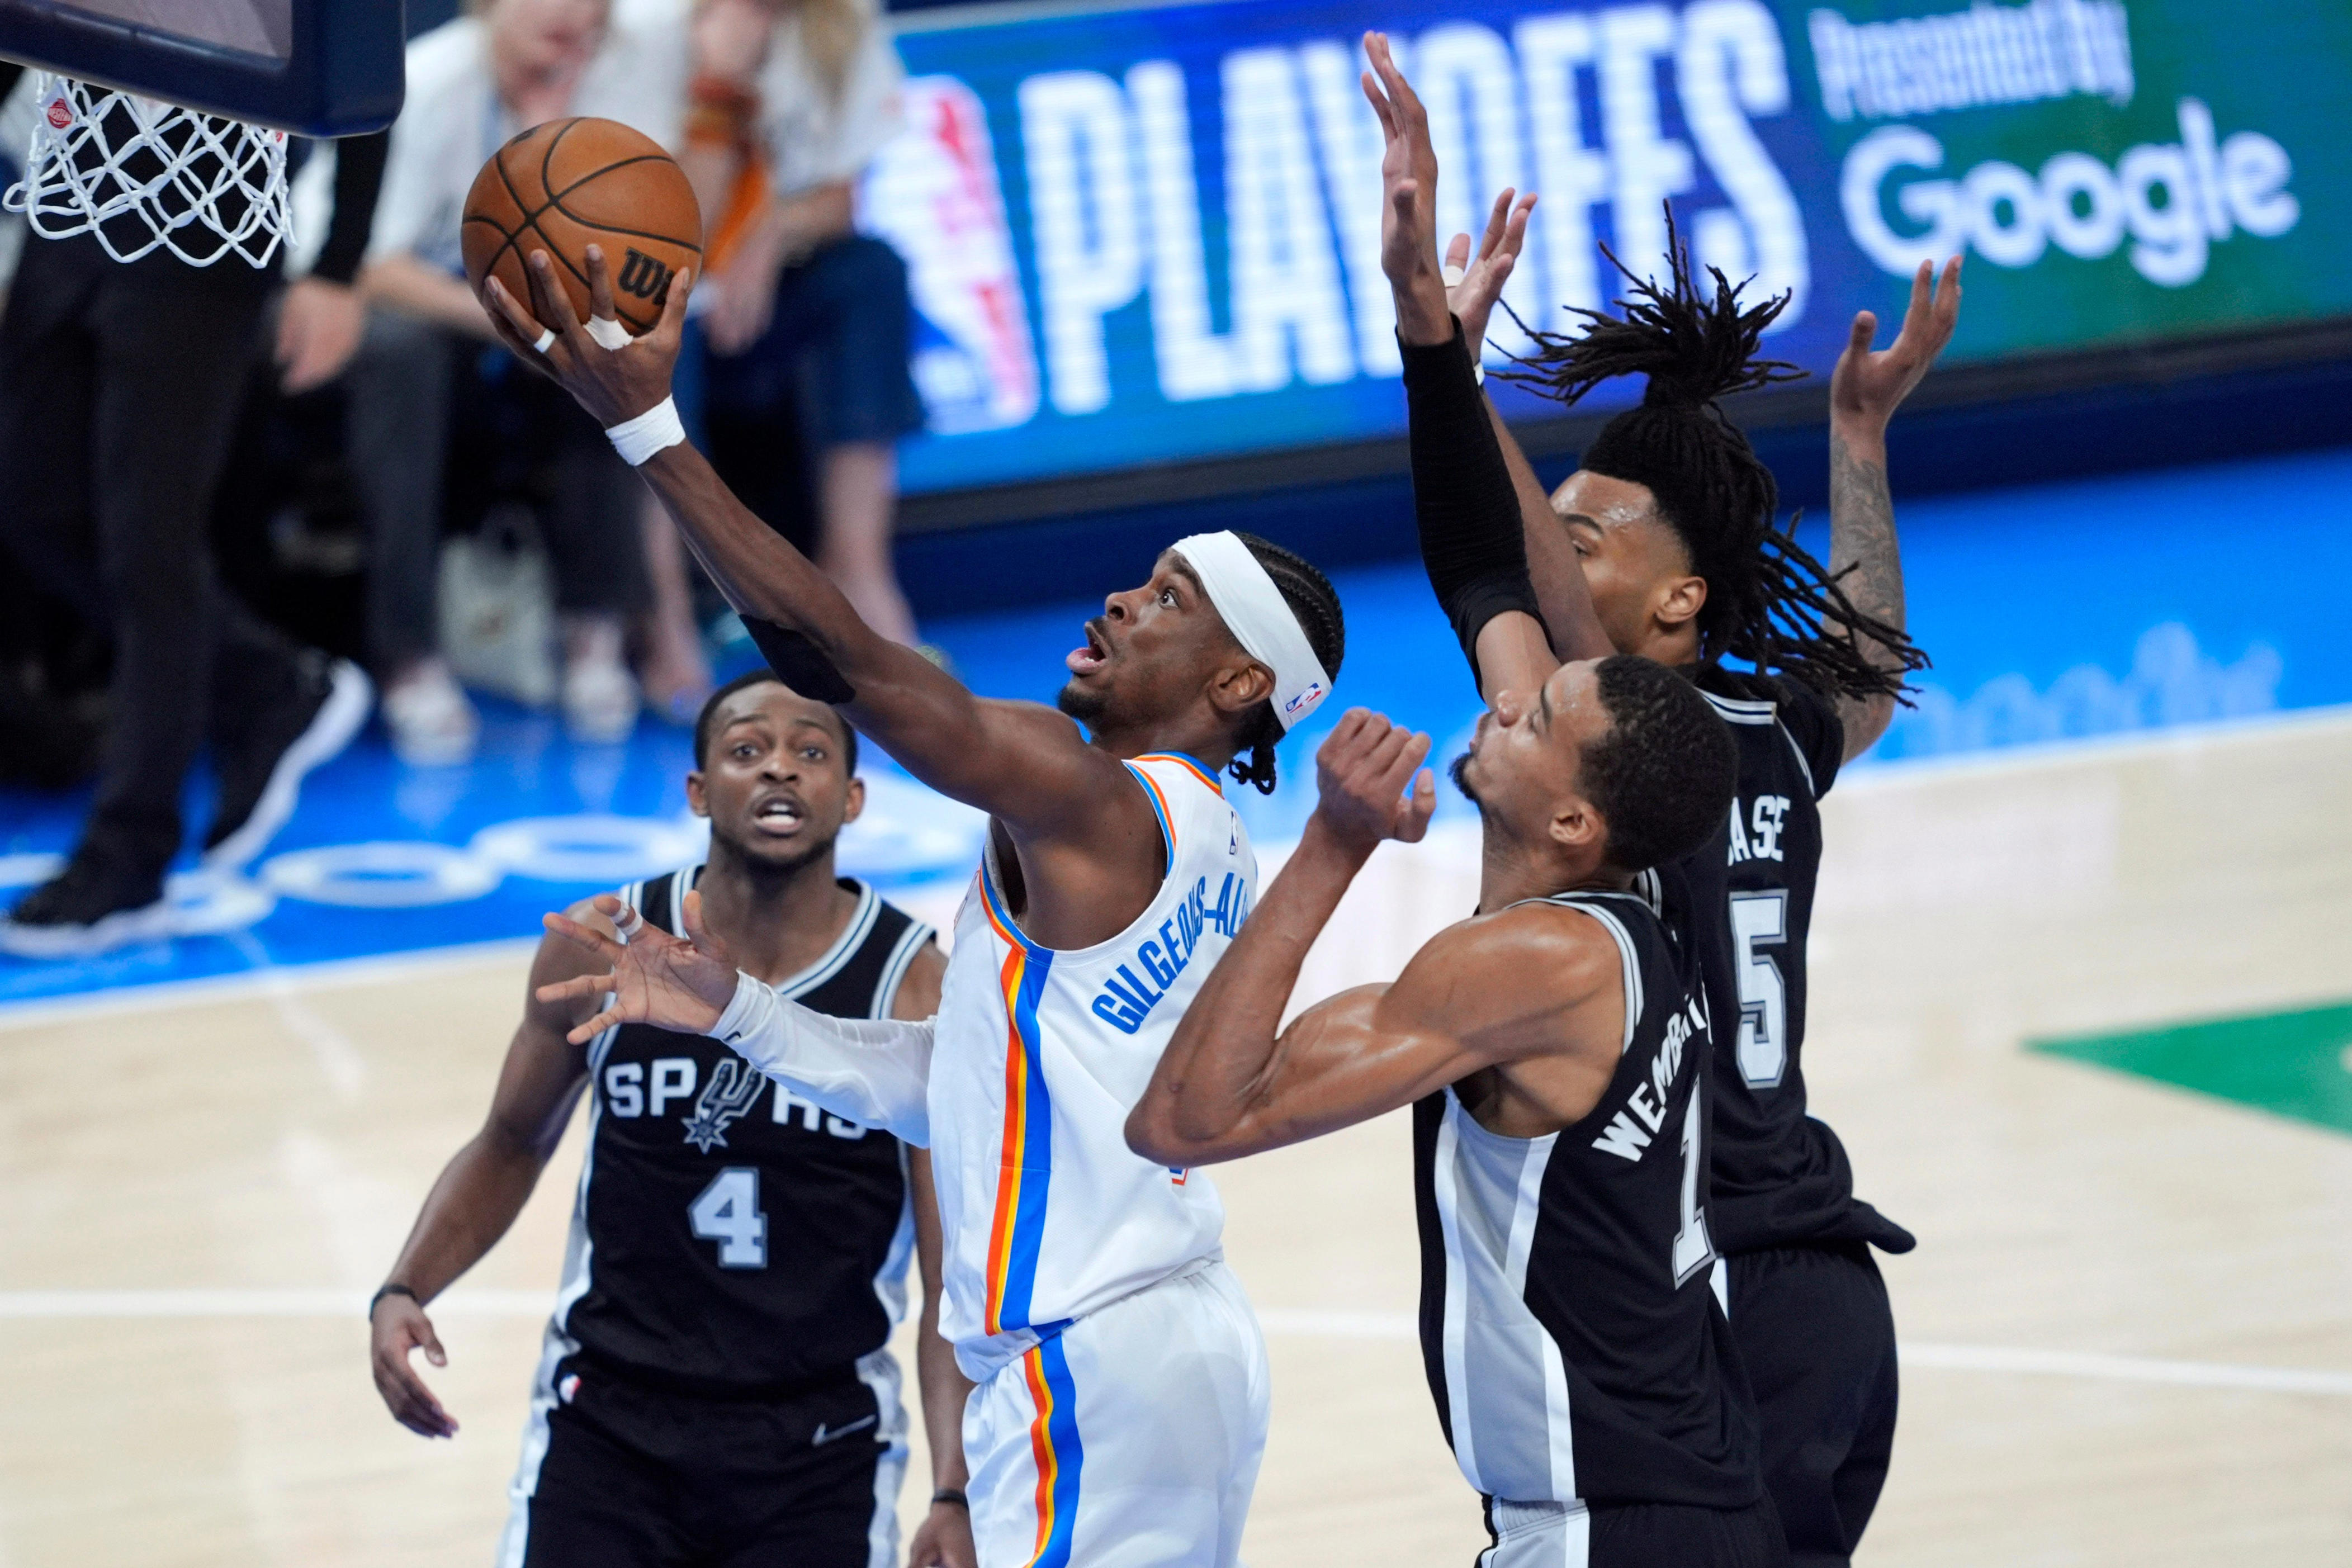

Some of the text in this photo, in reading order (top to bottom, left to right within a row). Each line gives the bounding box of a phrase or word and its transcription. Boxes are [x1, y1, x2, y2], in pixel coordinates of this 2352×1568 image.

[1806, 0, 2135, 123] Presented by
[1840, 97, 2301, 288] Google
[617, 246, 675, 306] Wi
[1730, 888, 1788, 1089] 5
[685, 1166, 769, 1269] 4
[1672, 1072, 1717, 1290] 1
